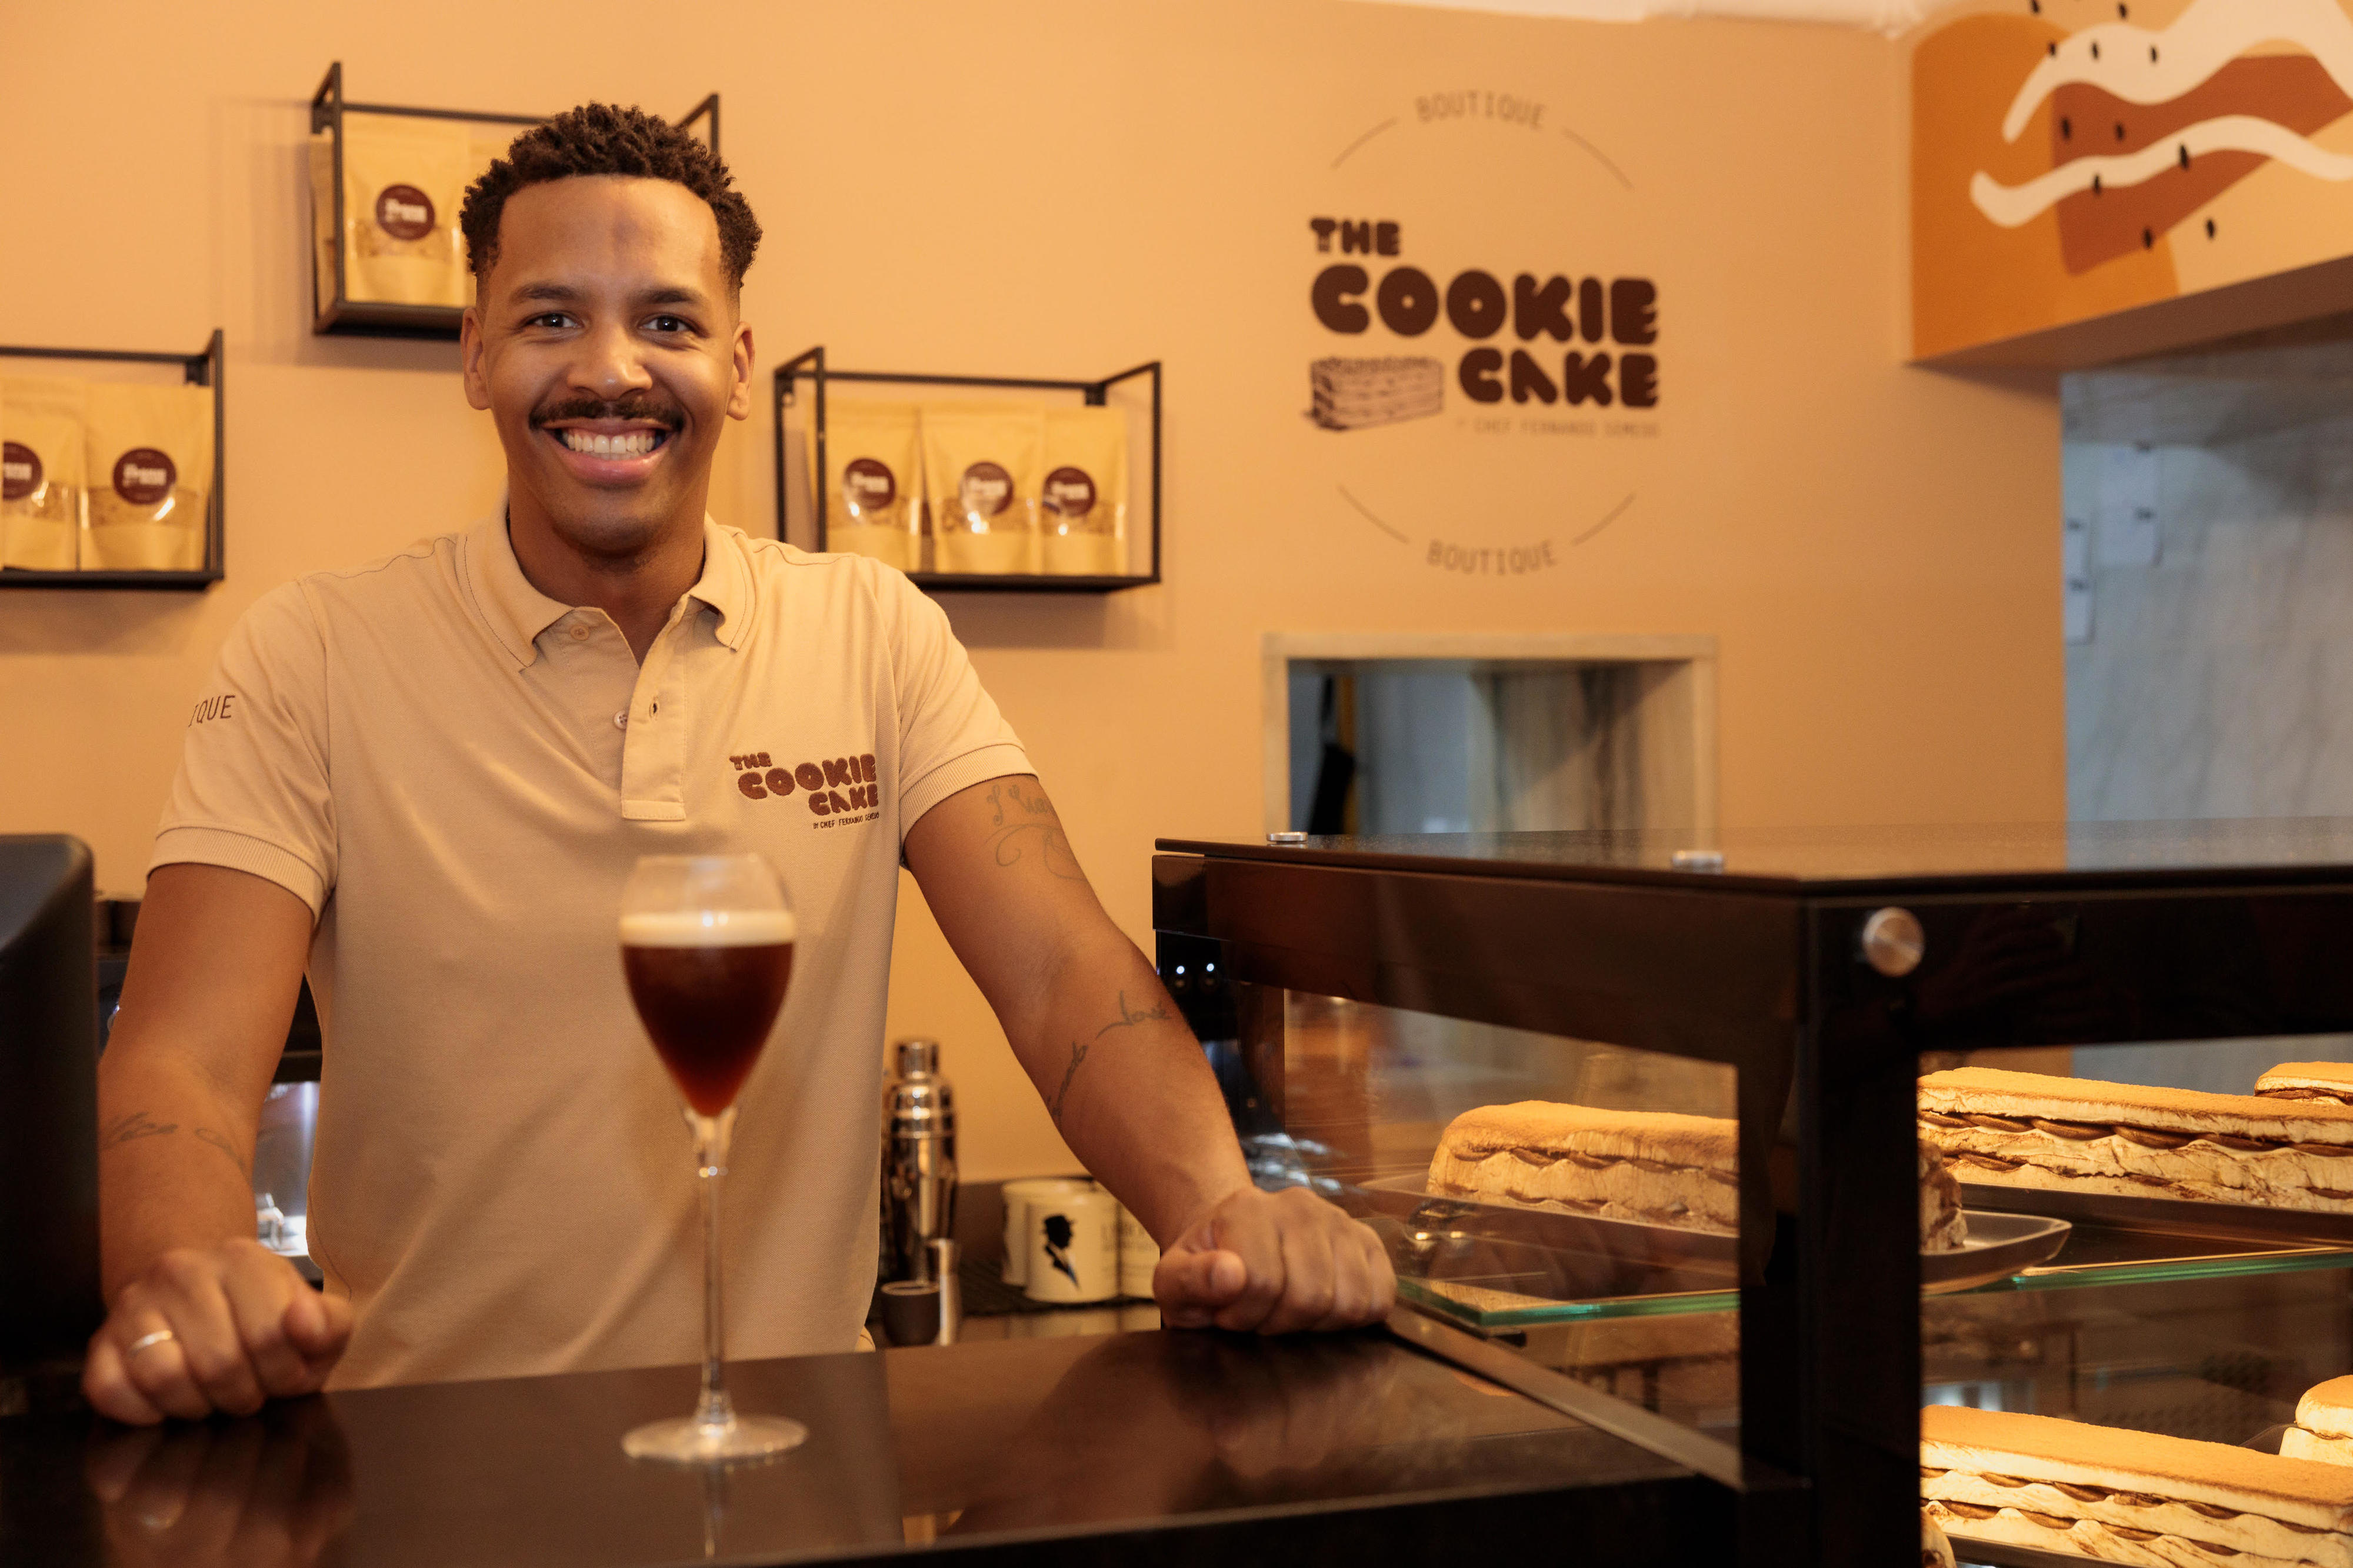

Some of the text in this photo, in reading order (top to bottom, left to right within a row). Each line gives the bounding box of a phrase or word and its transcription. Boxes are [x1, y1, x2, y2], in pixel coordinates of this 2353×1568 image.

[1416, 90, 1546, 130] BOUTIQUE
[1309, 217, 1401, 258] THE
[1310, 263, 1660, 346] COOKIE
[1458, 347, 1659, 409] CAKE
[1427, 540, 1558, 576] BOUTIQUE
[729, 752, 772, 770] THE
[738, 753, 876, 800] COOKIE
[808, 783, 878, 816] CAKE
[820, 819, 835, 829] CHEF
